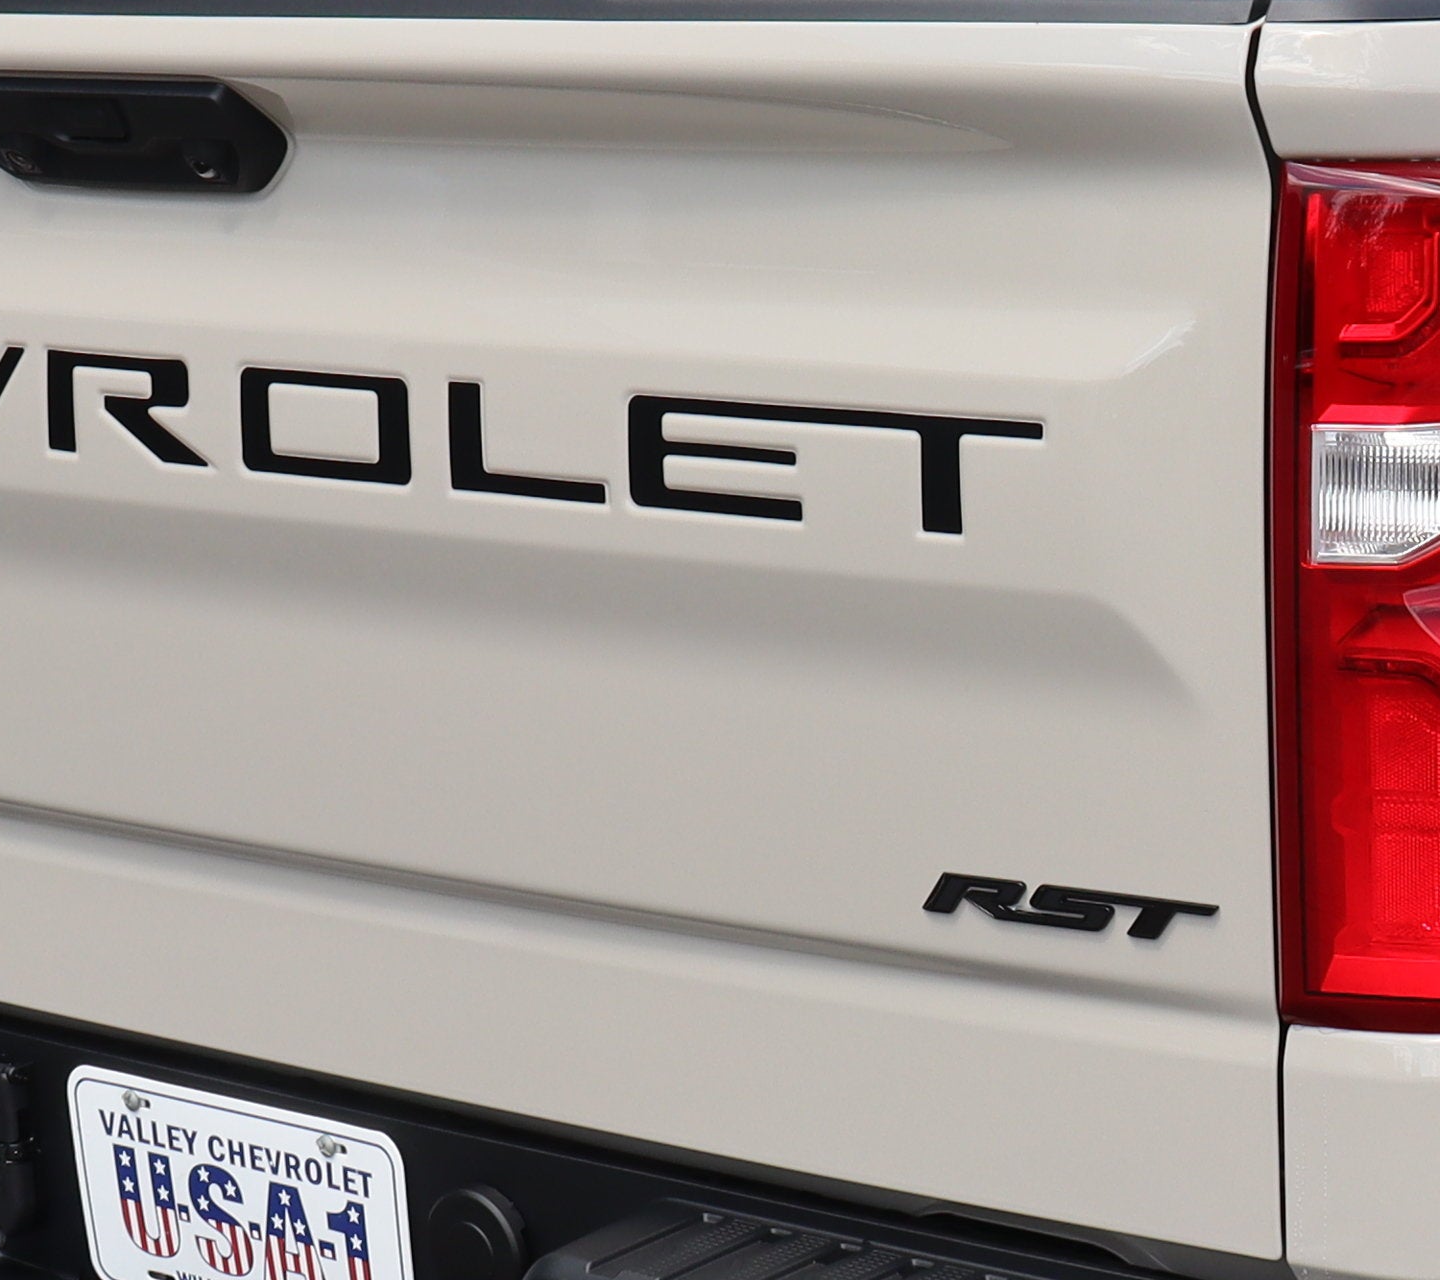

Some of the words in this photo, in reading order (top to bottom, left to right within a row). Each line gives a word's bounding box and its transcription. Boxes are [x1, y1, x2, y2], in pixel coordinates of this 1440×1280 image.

[921, 871, 1220, 941] RST
[98, 1109, 198, 1156] VALLEY
[207, 1134, 373, 1199] CHEVROLET
